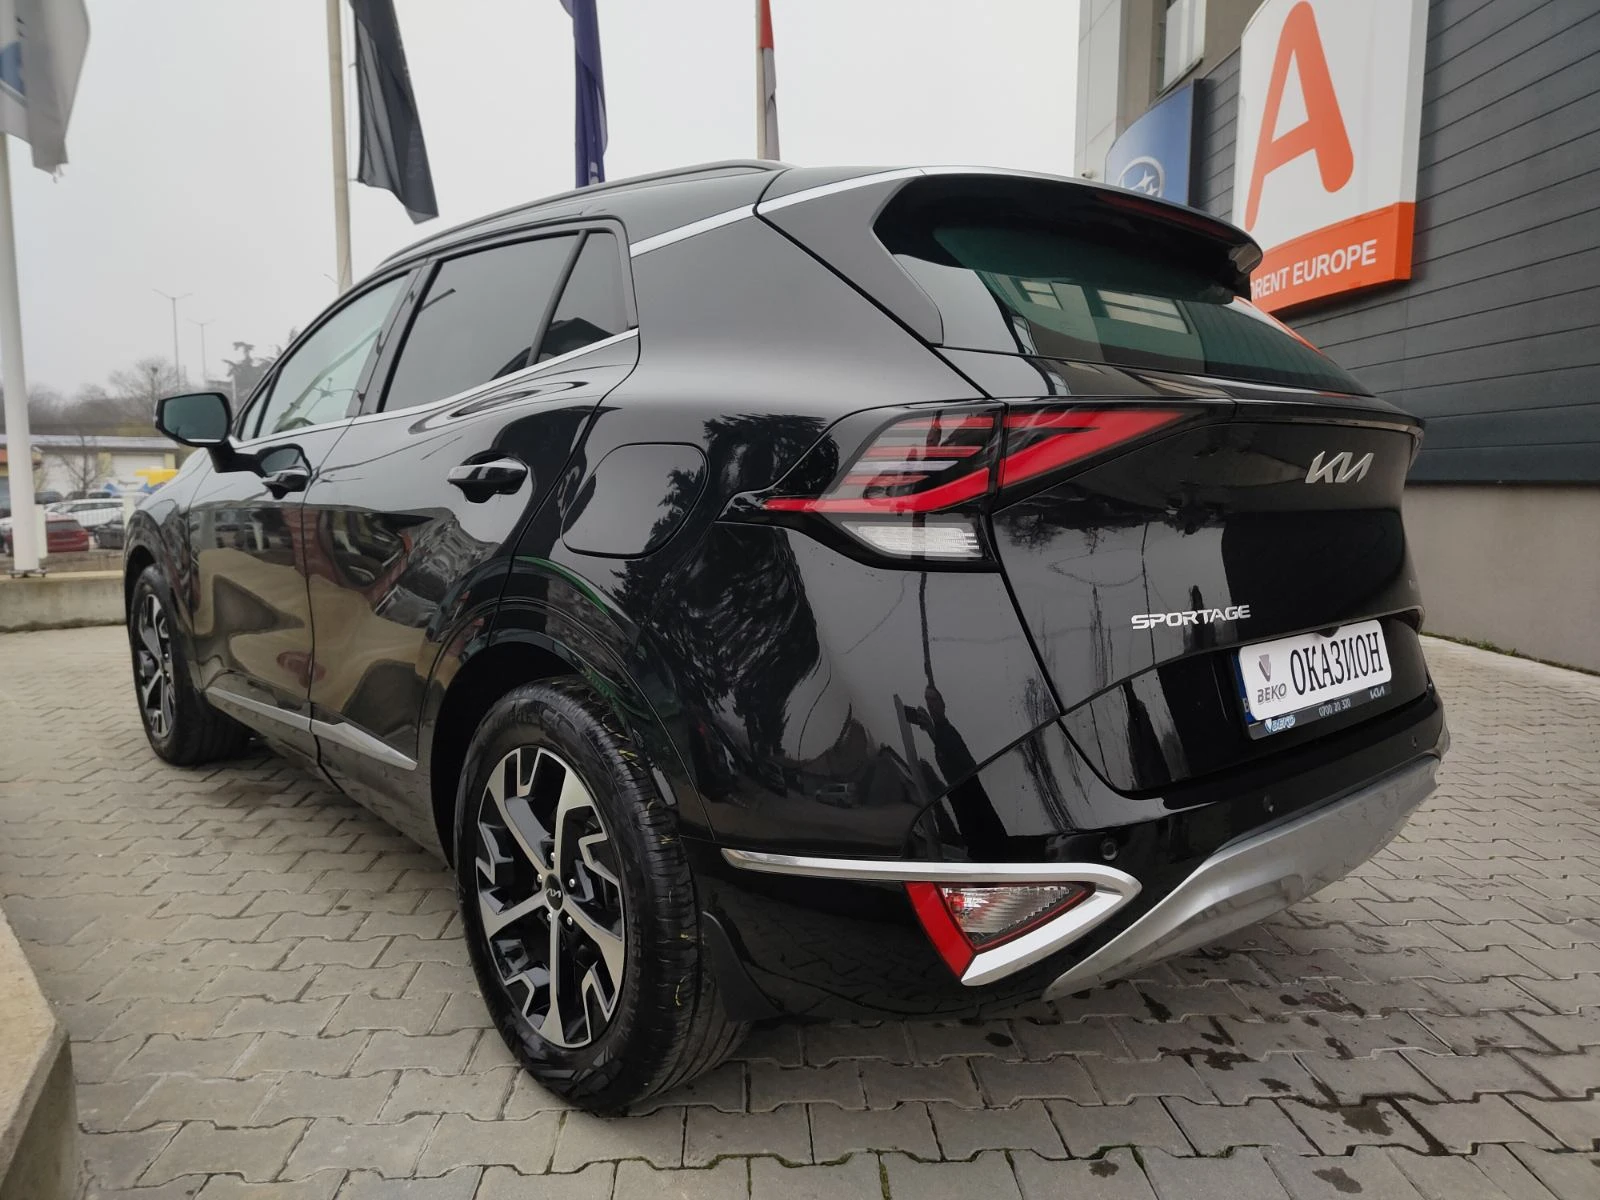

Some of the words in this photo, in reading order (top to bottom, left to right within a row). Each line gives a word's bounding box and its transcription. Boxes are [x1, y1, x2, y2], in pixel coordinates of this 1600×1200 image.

[1245, 1, 1354, 232] A
[1293, 239, 1377, 286] EUROPE
[1131, 604, 1251, 630] SPORTAGE
[1290, 632, 1384, 695] ОКАЗИОН
